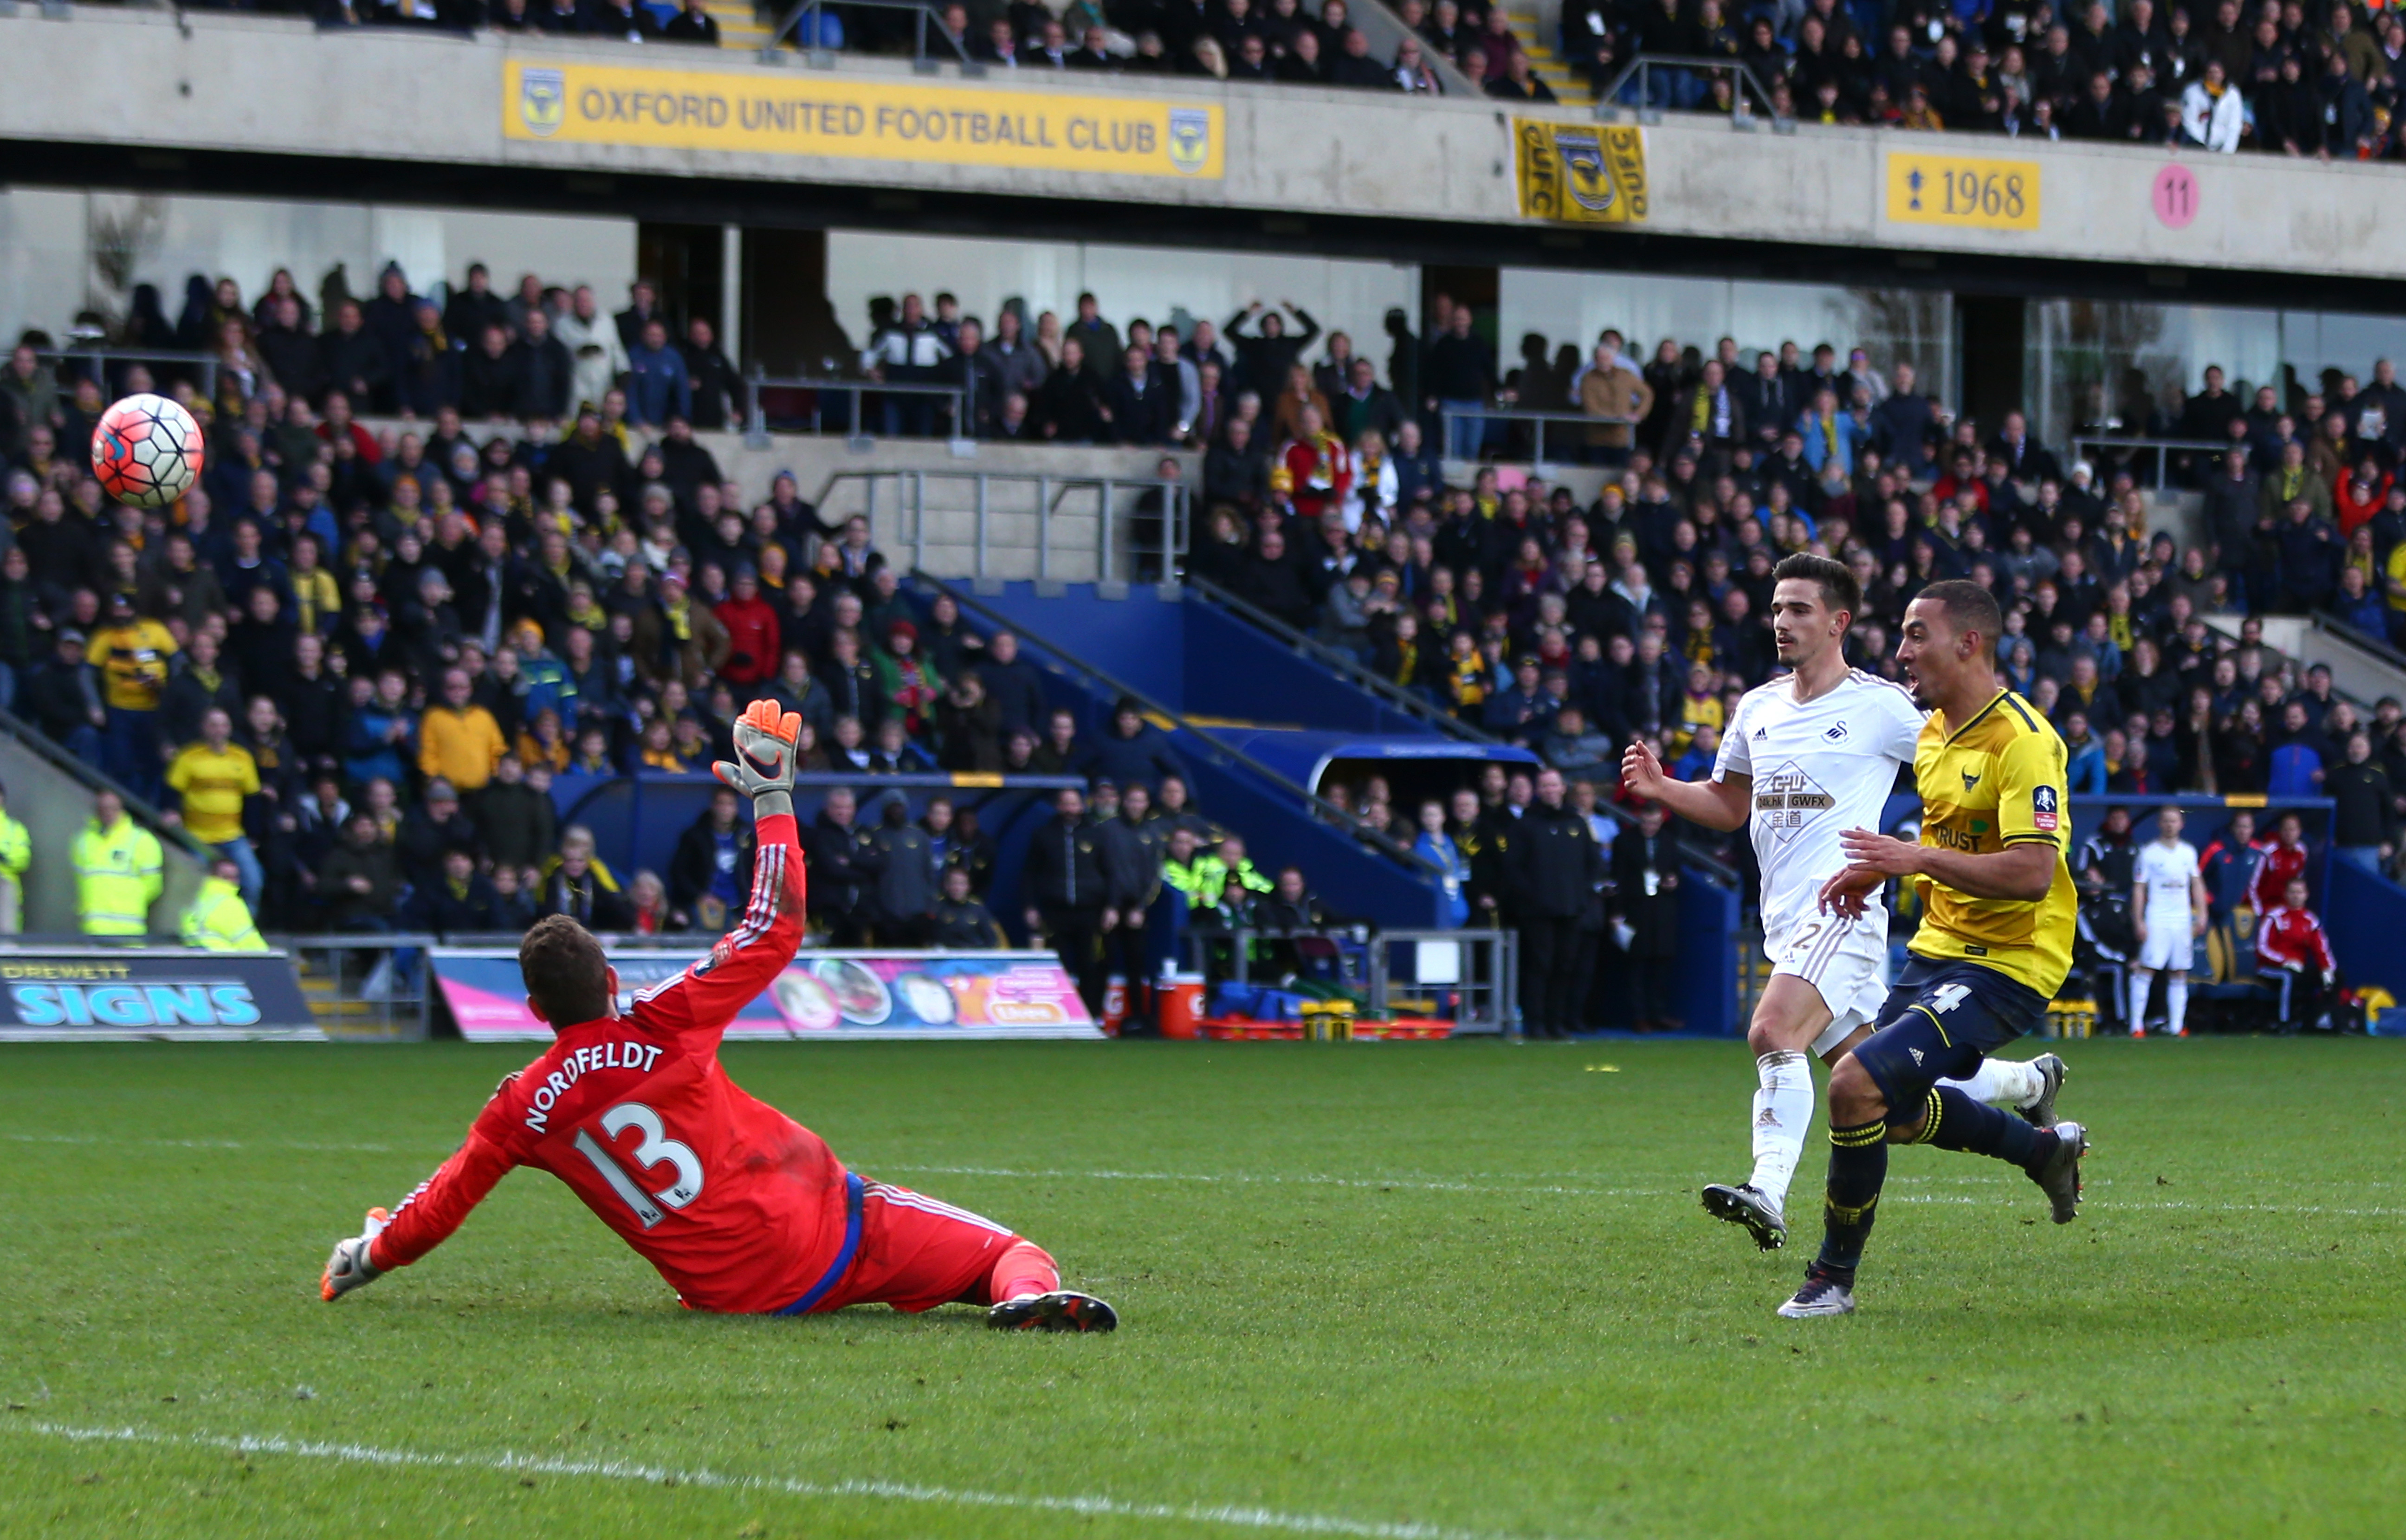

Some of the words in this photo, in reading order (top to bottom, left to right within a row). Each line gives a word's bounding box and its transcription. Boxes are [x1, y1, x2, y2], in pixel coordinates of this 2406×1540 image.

[579, 86, 729, 125] OXFORD
[741, 98, 866, 136] UNITED
[873, 103, 1058, 149] FOOTBALL
[1065, 117, 1158, 155] CLUB
[1941, 170, 2025, 220] 1968
[2165, 177, 2191, 217] 11
[1772, 810, 1801, 828] 金道
[1792, 796, 1825, 807] GWFX
[1932, 824, 1982, 852] TRUST
[2, 964, 131, 980] DREWETT
[10, 983, 262, 1026] SIGNS
[1931, 983, 1973, 1015] 4
[525, 1042, 663, 1134] NORDFELDT
[574, 1101, 705, 1230] 13
